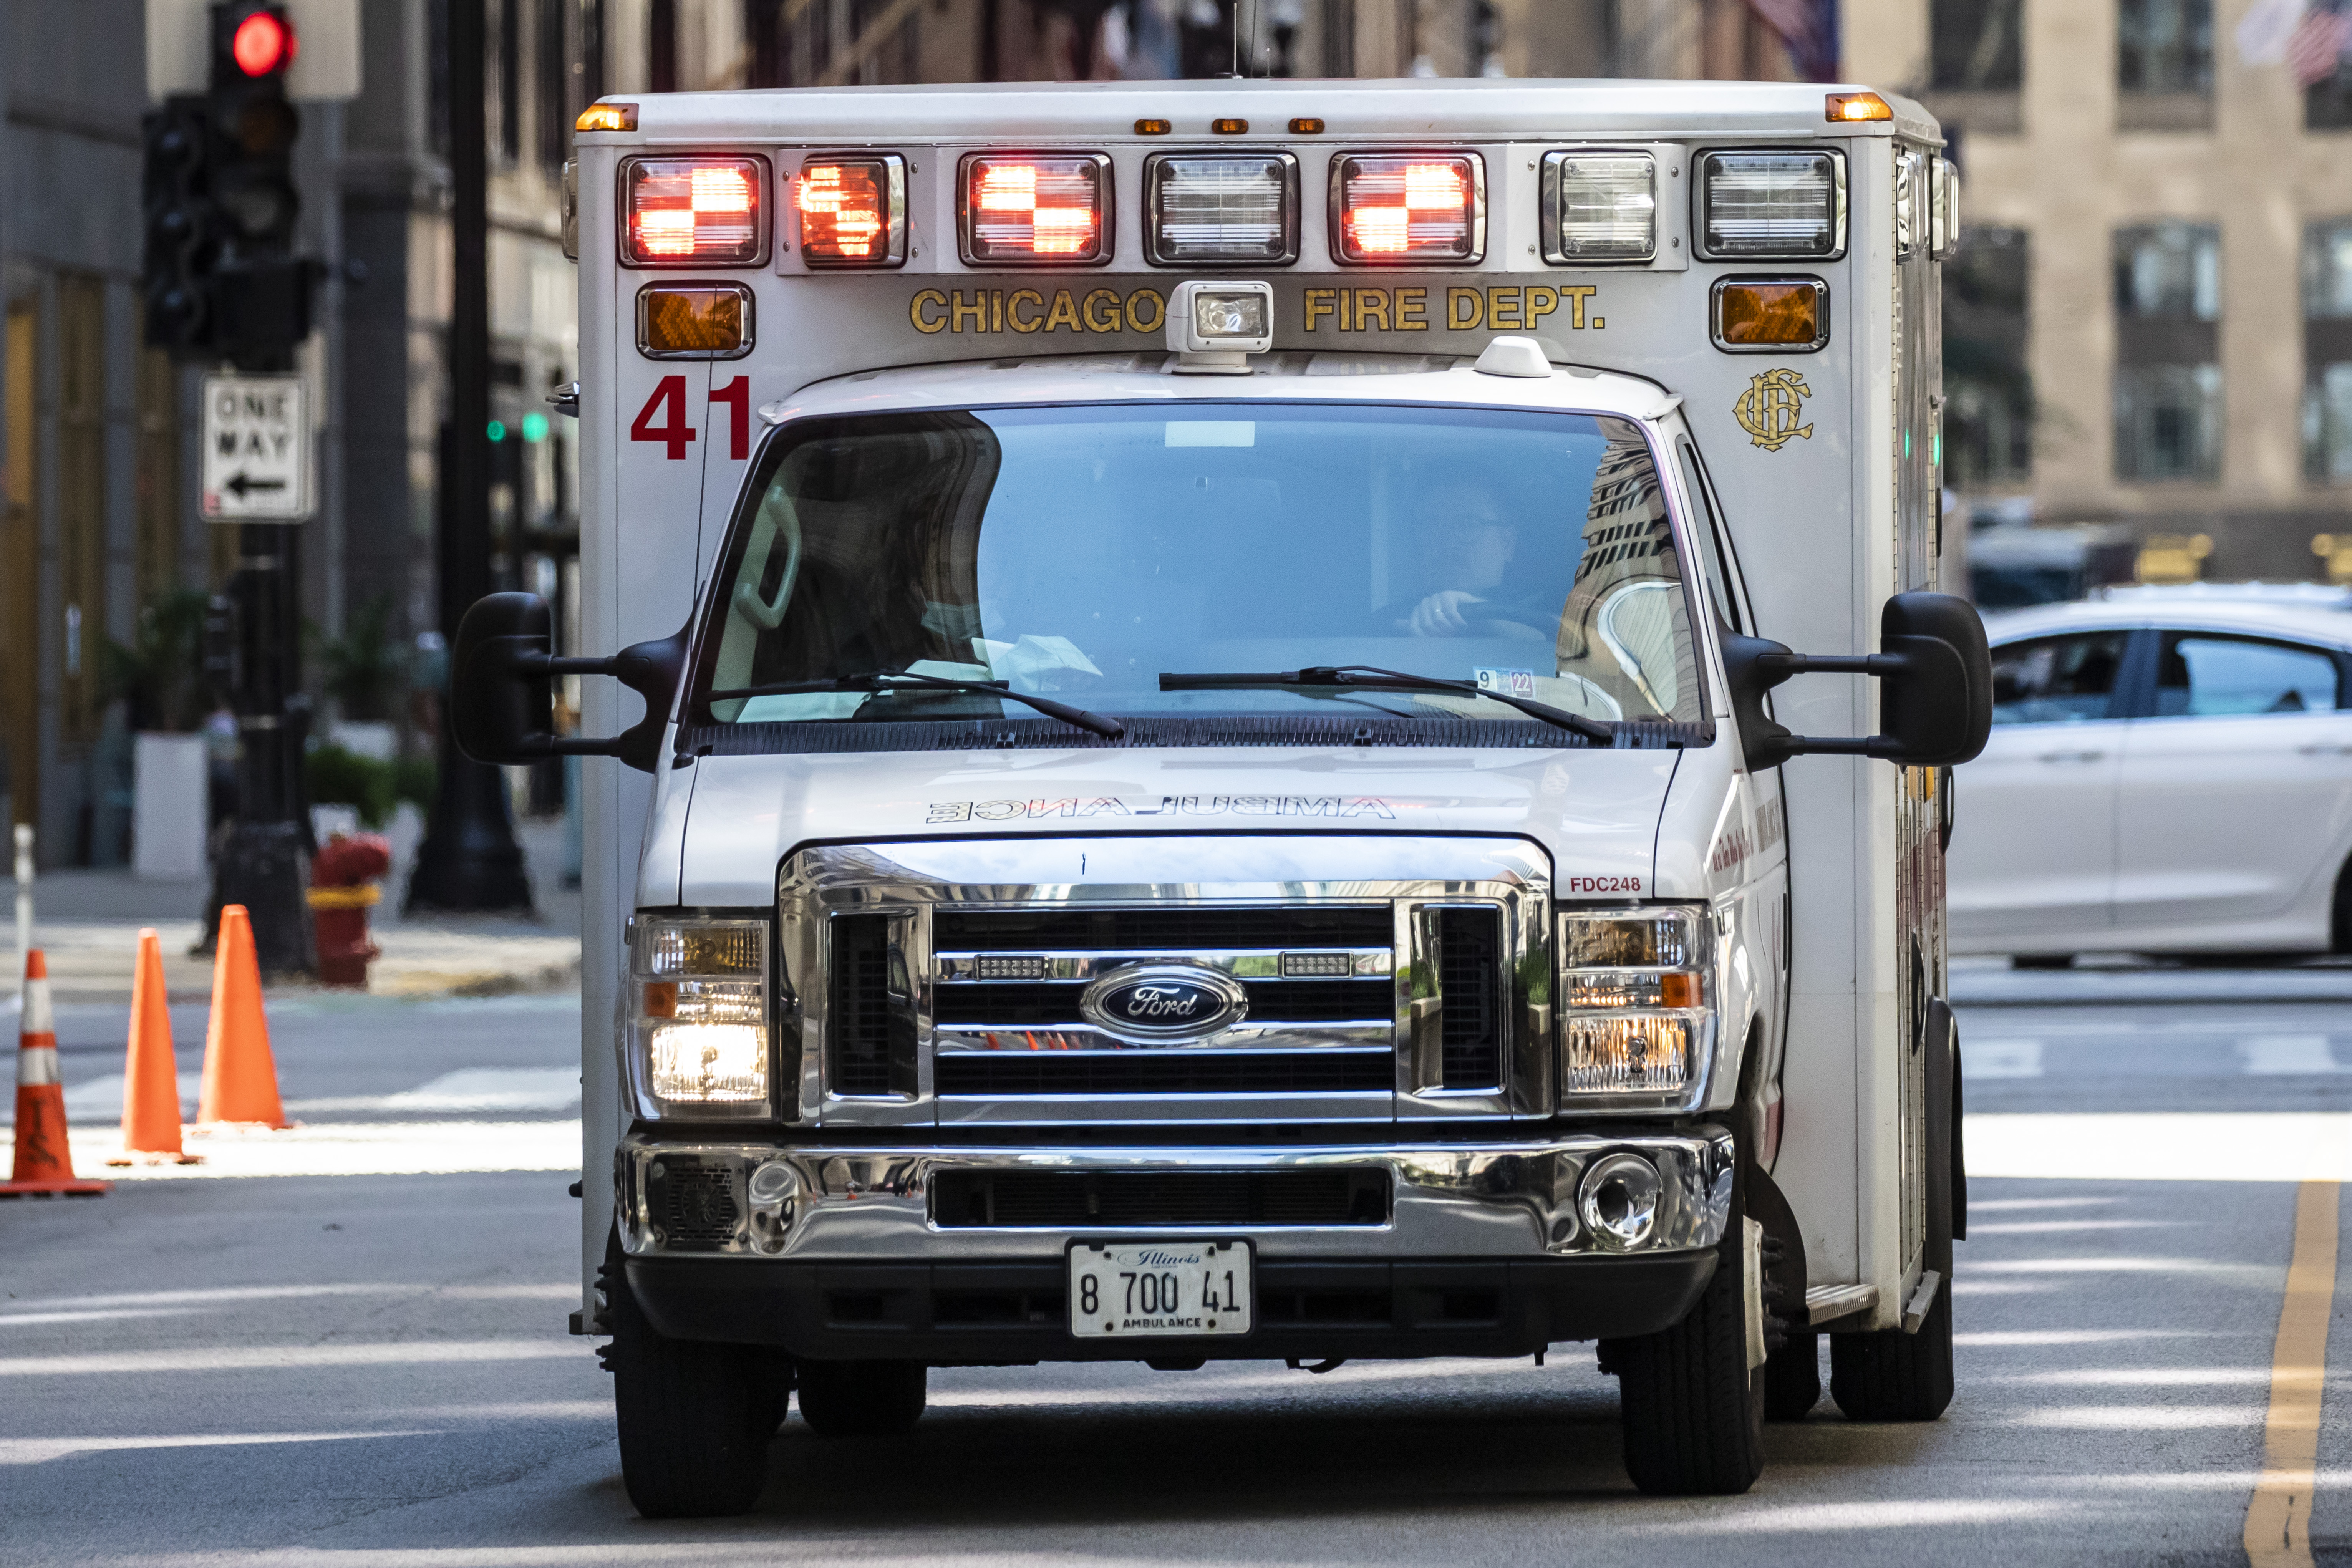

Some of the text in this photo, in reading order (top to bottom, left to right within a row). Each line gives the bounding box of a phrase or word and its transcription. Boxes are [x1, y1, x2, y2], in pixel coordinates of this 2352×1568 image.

[909, 285, 1606, 334] CHICAGO FIRE DEPT.
[215, 391, 286, 420] ONE
[630, 375, 749, 460] 41
[215, 429, 293, 459] WAY
[1480, 671, 1531, 692] 9 22
[1570, 877, 1641, 892] FDC248
[1127, 986, 1198, 1016] Ford
[1117, 1248, 1202, 1266] Illinois
[1080, 1270, 1240, 1315] 8 700 41
[1123, 1317, 1202, 1328] AMBULANCE
